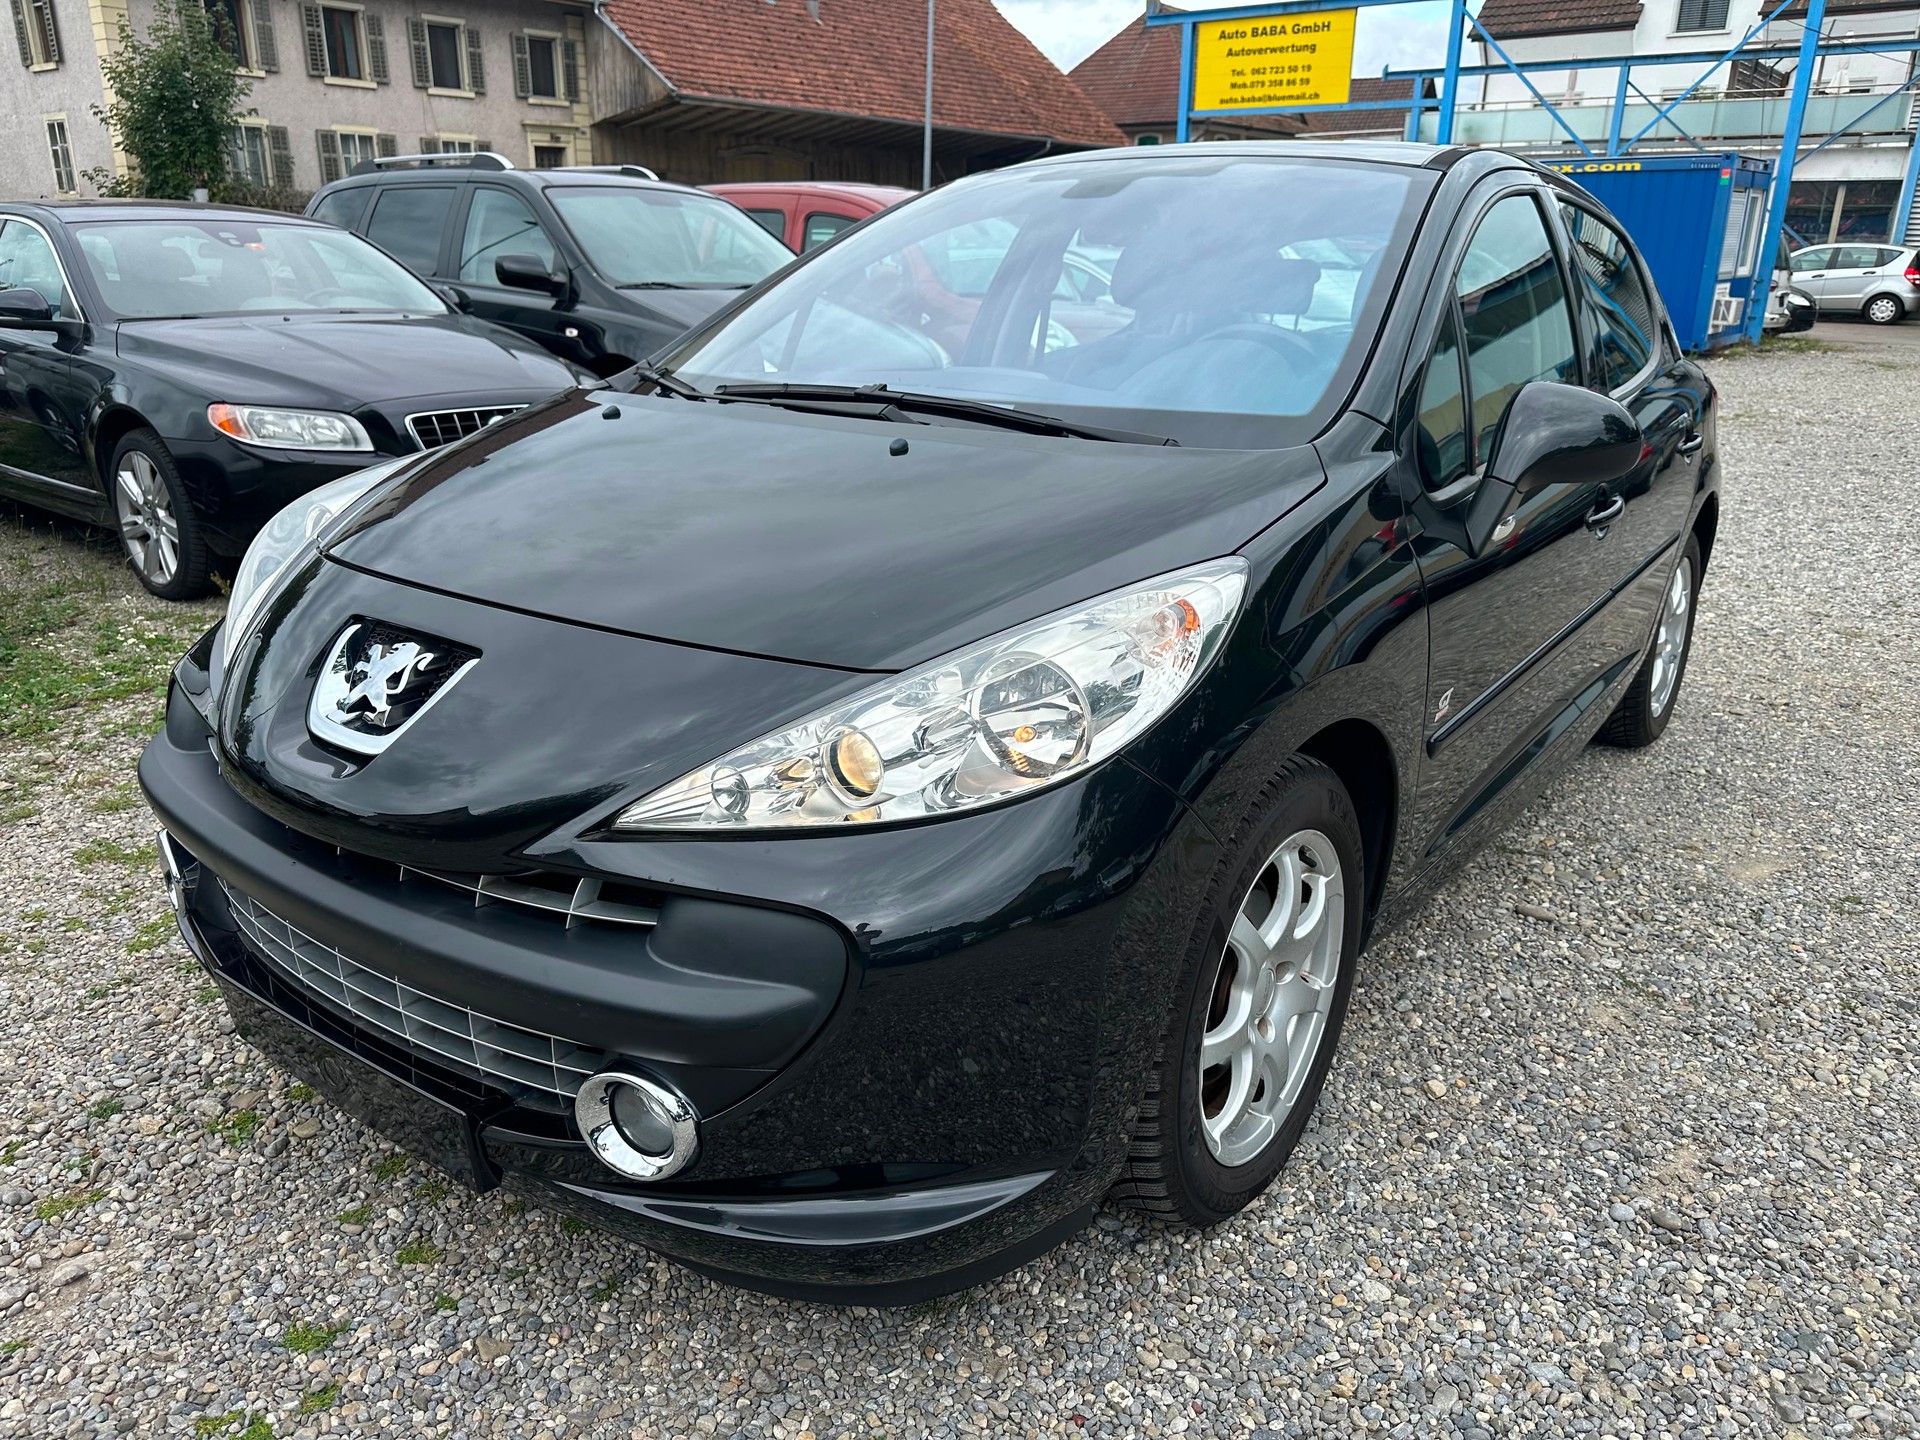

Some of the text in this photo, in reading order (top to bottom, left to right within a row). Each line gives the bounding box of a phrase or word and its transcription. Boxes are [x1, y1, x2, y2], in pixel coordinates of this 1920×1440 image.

[1218, 21, 1331, 41] Auto BABA GmbH
[1226, 43, 1317, 58] Autoverwertung
[1231, 69, 1247, 77] Tel.
[1250, 67, 1267, 76] 062
